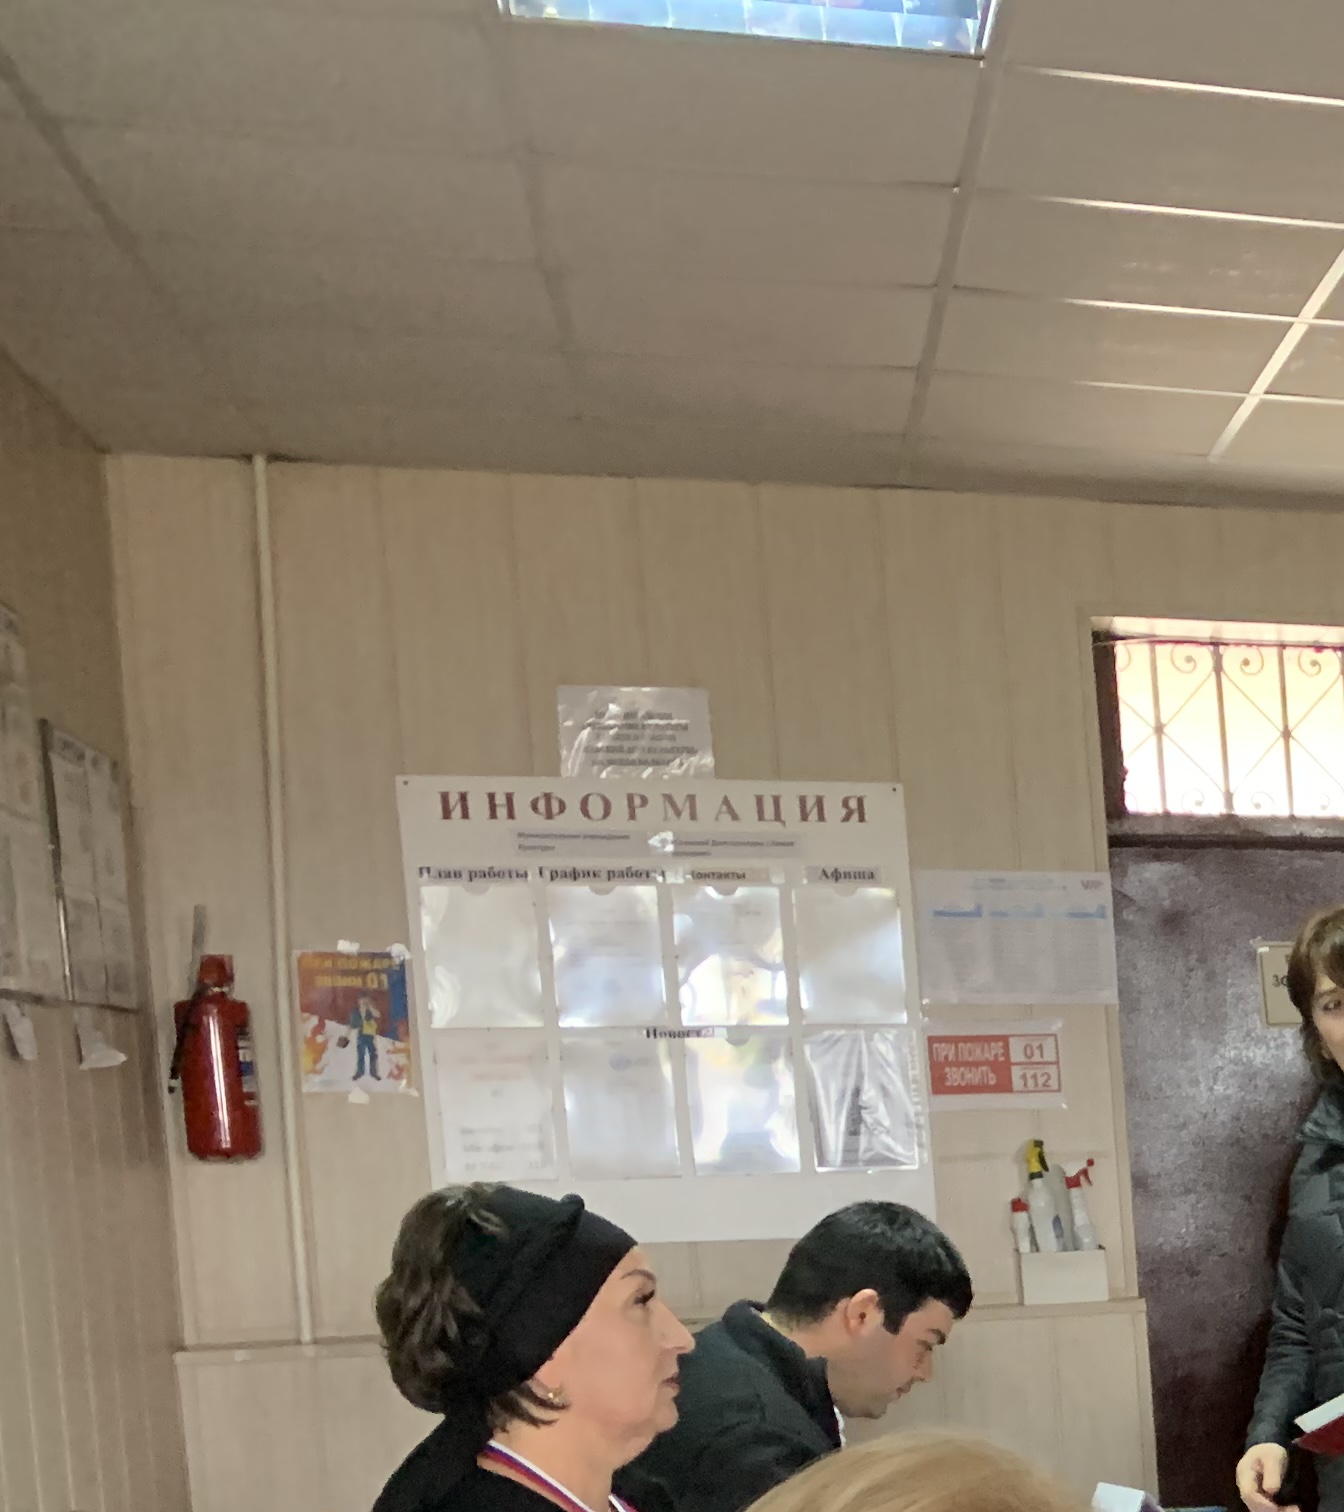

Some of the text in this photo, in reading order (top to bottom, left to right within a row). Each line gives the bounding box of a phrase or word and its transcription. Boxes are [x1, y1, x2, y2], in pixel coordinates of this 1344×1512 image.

[438, 790, 868, 828] ИНФОРМАЦИЯ
[467, 866, 529, 882] работы
[818, 867, 876, 883] Афиша
[932, 1041, 1045, 1063] ПРИ ПОЖАРЕ 01
[944, 1066, 1052, 1089] ЗВОНИТЬ 112
